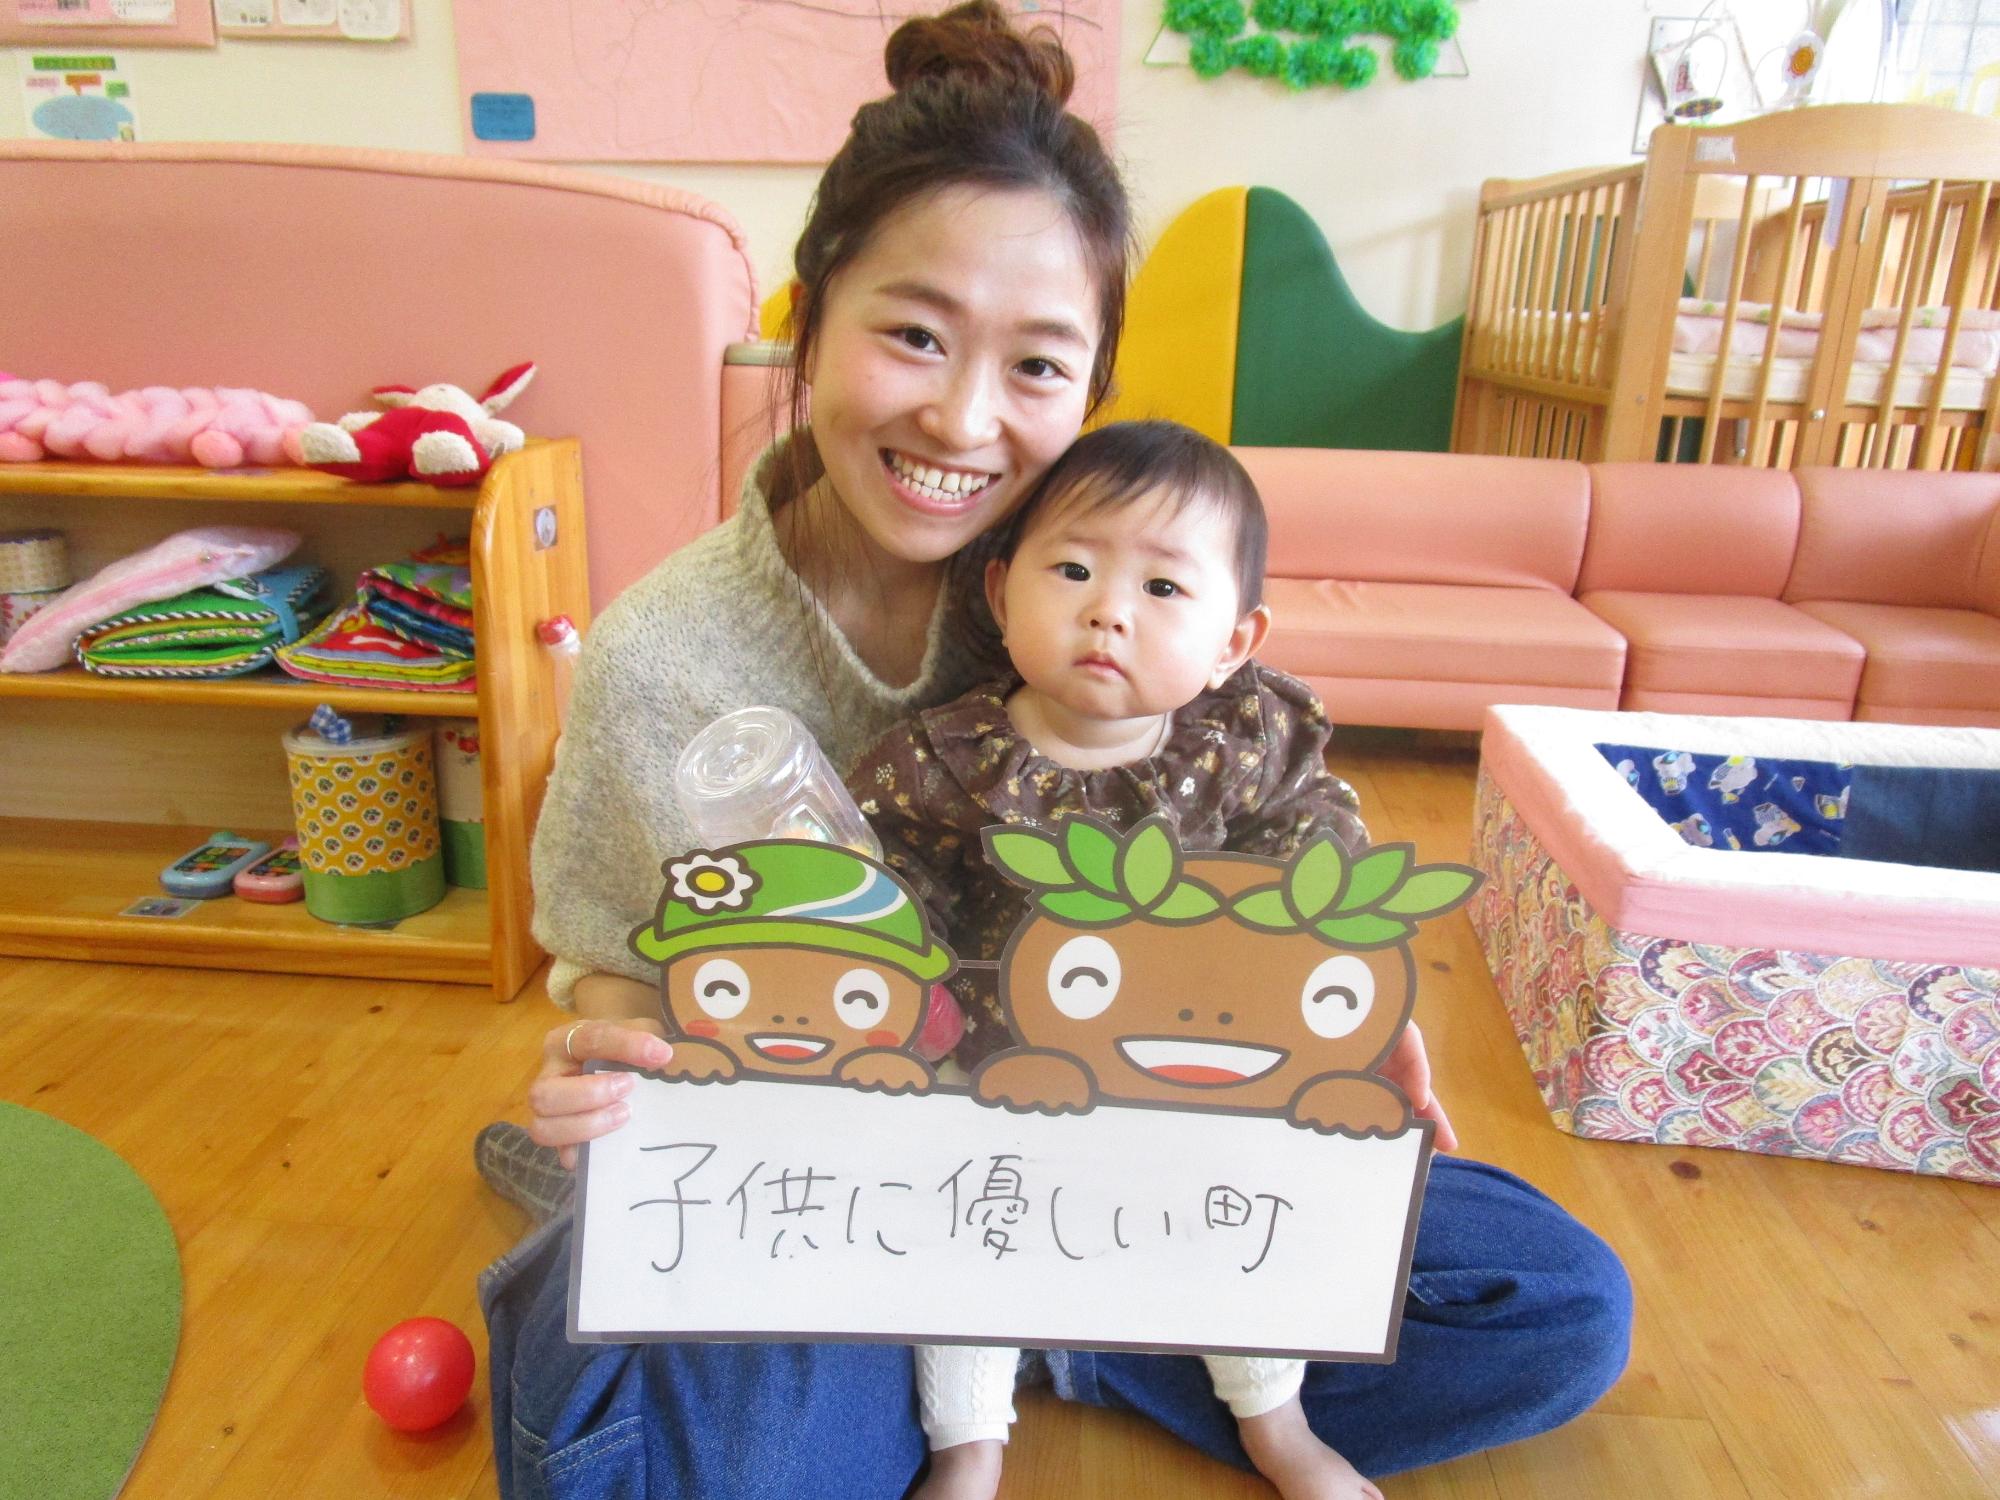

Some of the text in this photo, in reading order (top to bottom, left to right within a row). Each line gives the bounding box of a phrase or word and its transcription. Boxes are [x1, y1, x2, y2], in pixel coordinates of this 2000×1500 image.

[629, 1142, 1294, 1274] 子供に優しい町
